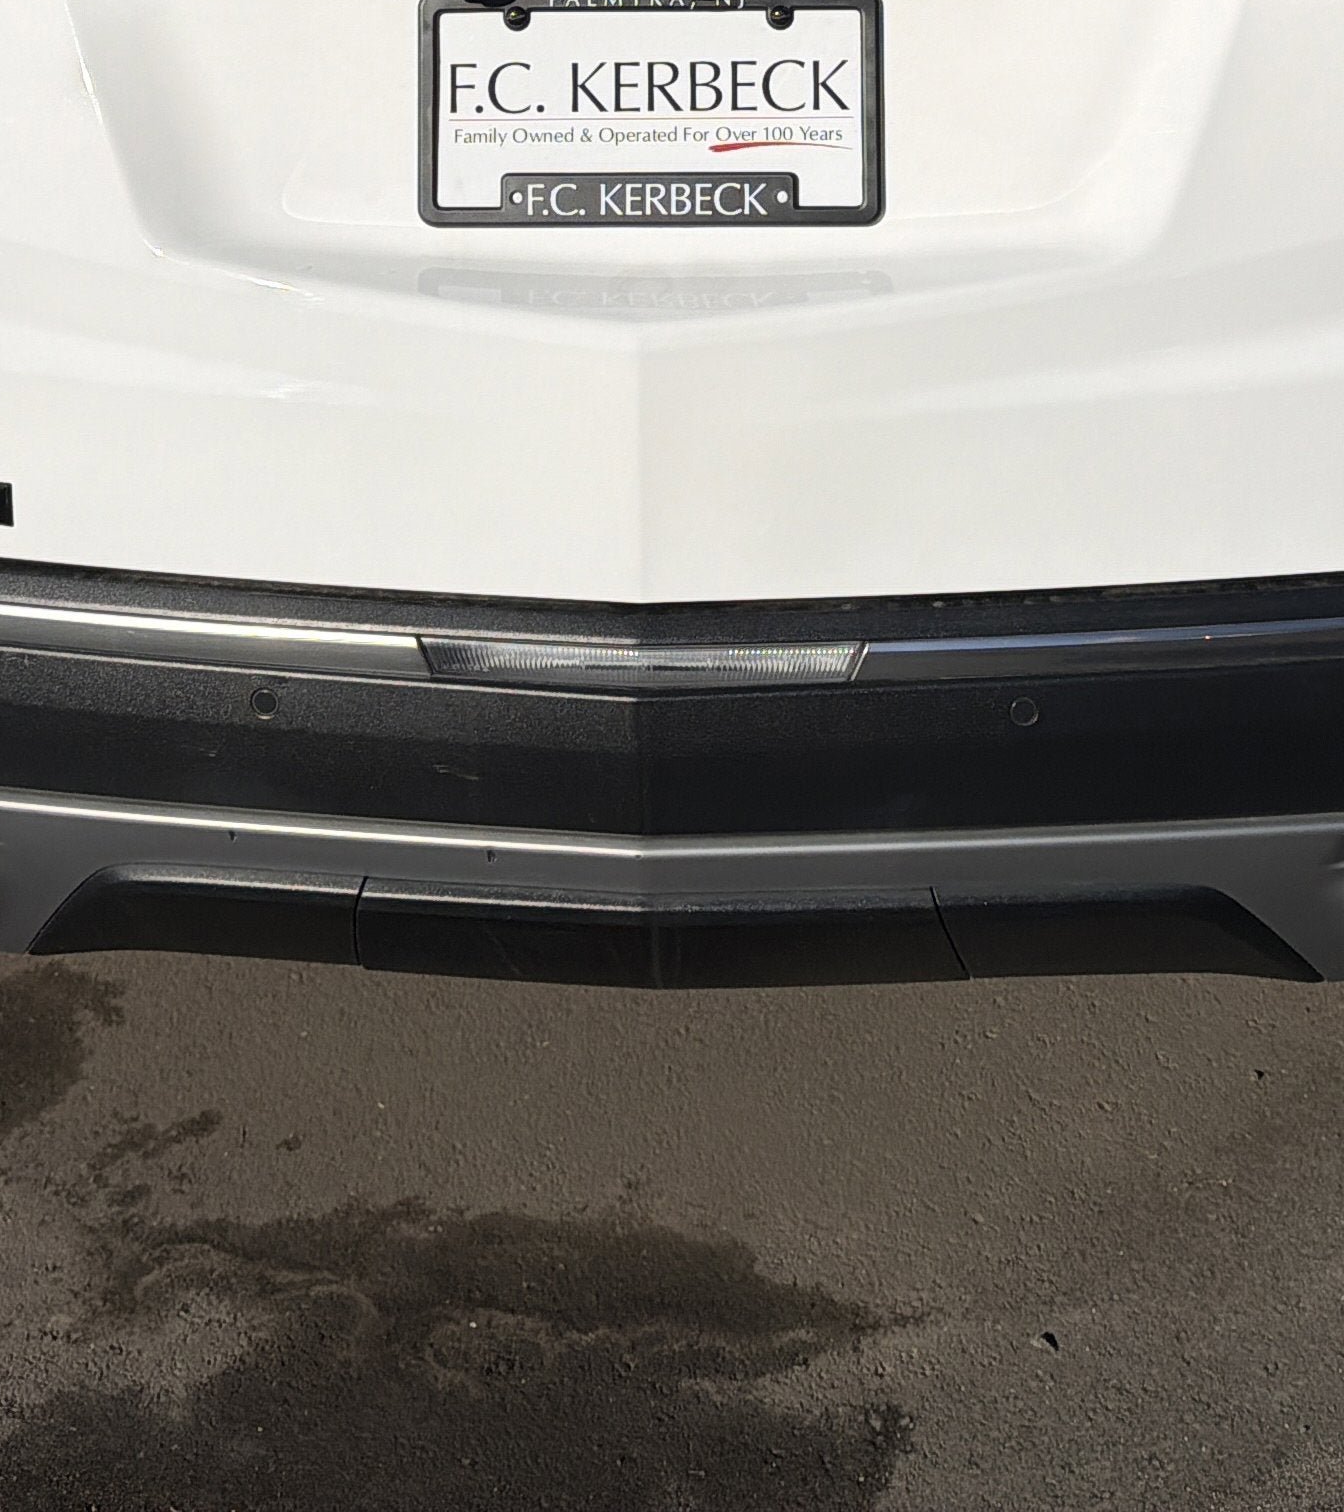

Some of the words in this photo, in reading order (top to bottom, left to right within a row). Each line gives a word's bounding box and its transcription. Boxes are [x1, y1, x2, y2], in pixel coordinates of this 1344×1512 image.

[450, 62, 545, 114] F.C.
[571, 59, 850, 113] KERBECK
[454, 128, 508, 147] Family
[512, 127, 574, 144] Owned
[580, 127, 593, 143] &
[599, 126, 678, 146] Operated
[683, 127, 710, 142] For
[716, 126, 758, 142] Over
[763, 126, 793, 141] 100
[799, 125, 843, 141] Years
[527, 184, 586, 216] F.C.
[600, 183, 768, 216] KERBECK
